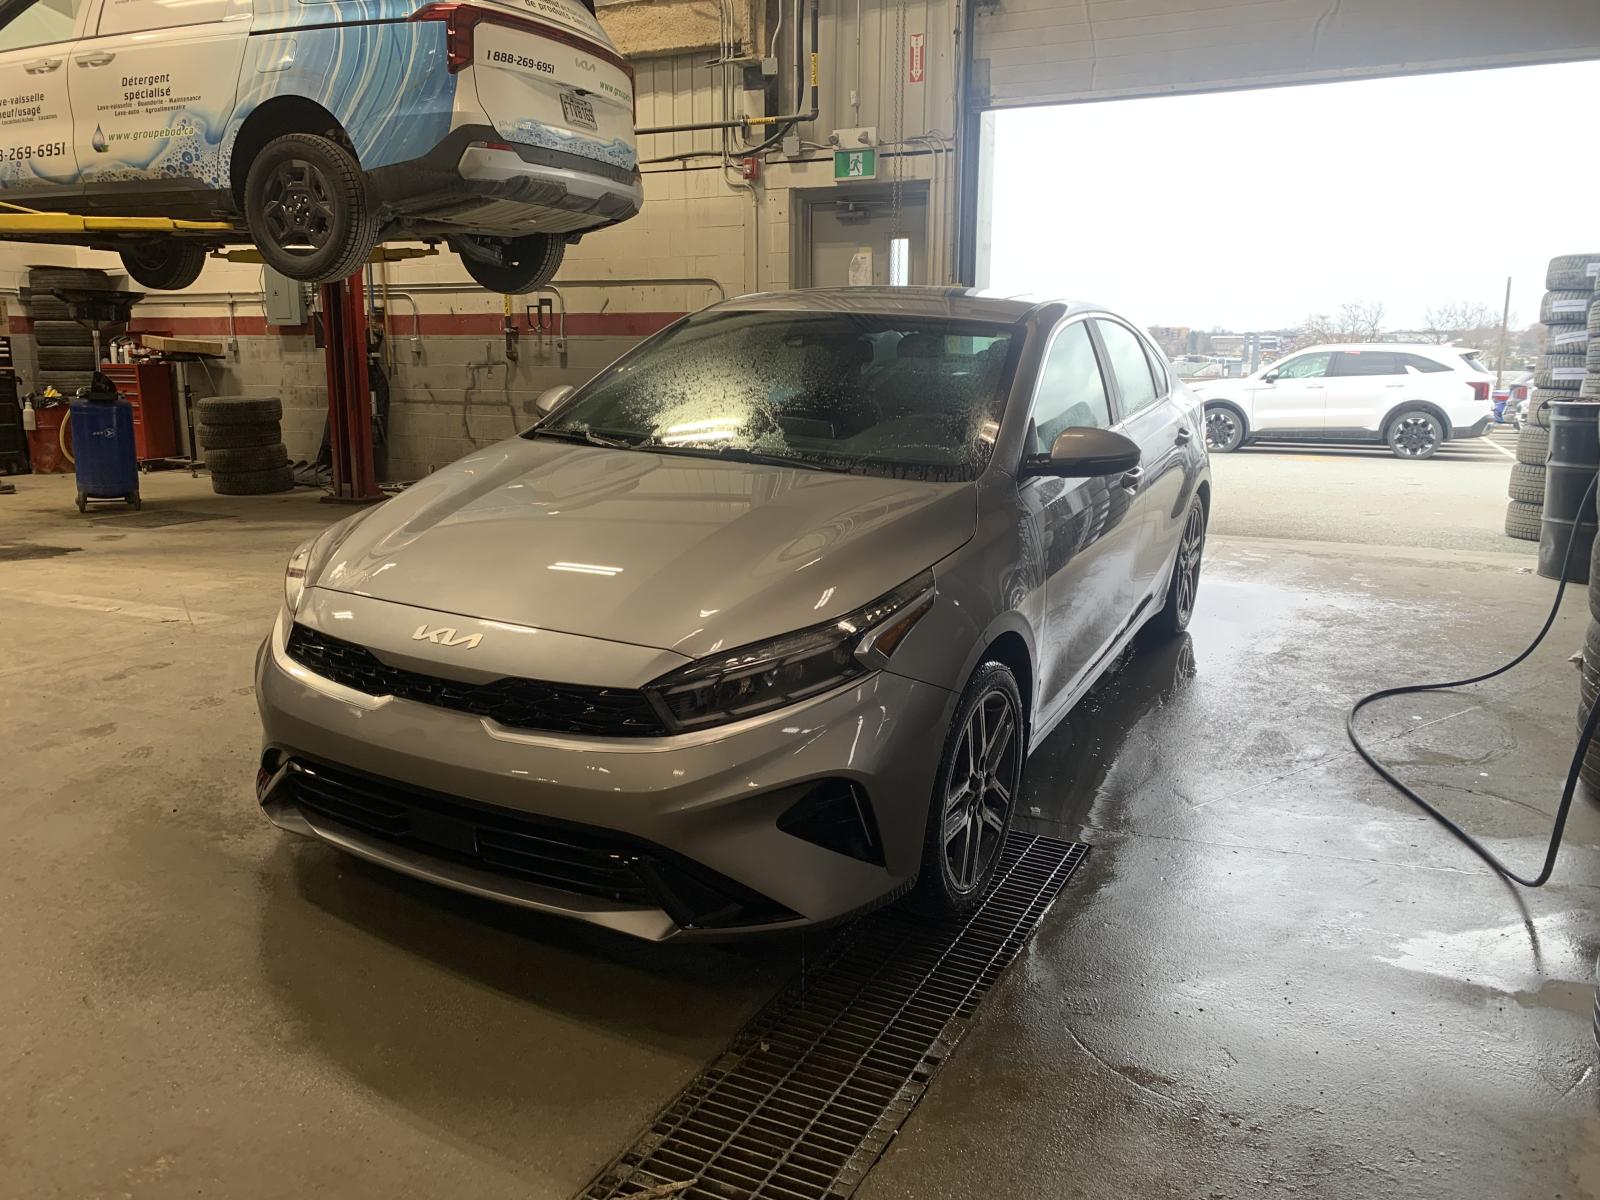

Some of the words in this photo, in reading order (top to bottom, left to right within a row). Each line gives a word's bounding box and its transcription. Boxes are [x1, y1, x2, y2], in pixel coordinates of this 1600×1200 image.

[487, 50, 491, 60] 1
[493, 51, 555, 74] 888-269-6951
[122, 73, 170, 86] Détergent
[124, 87, 171, 101] spécialisé
[108, 126, 194, 141] www.groupebod.ca
[411, 623, 483, 650] KIA
